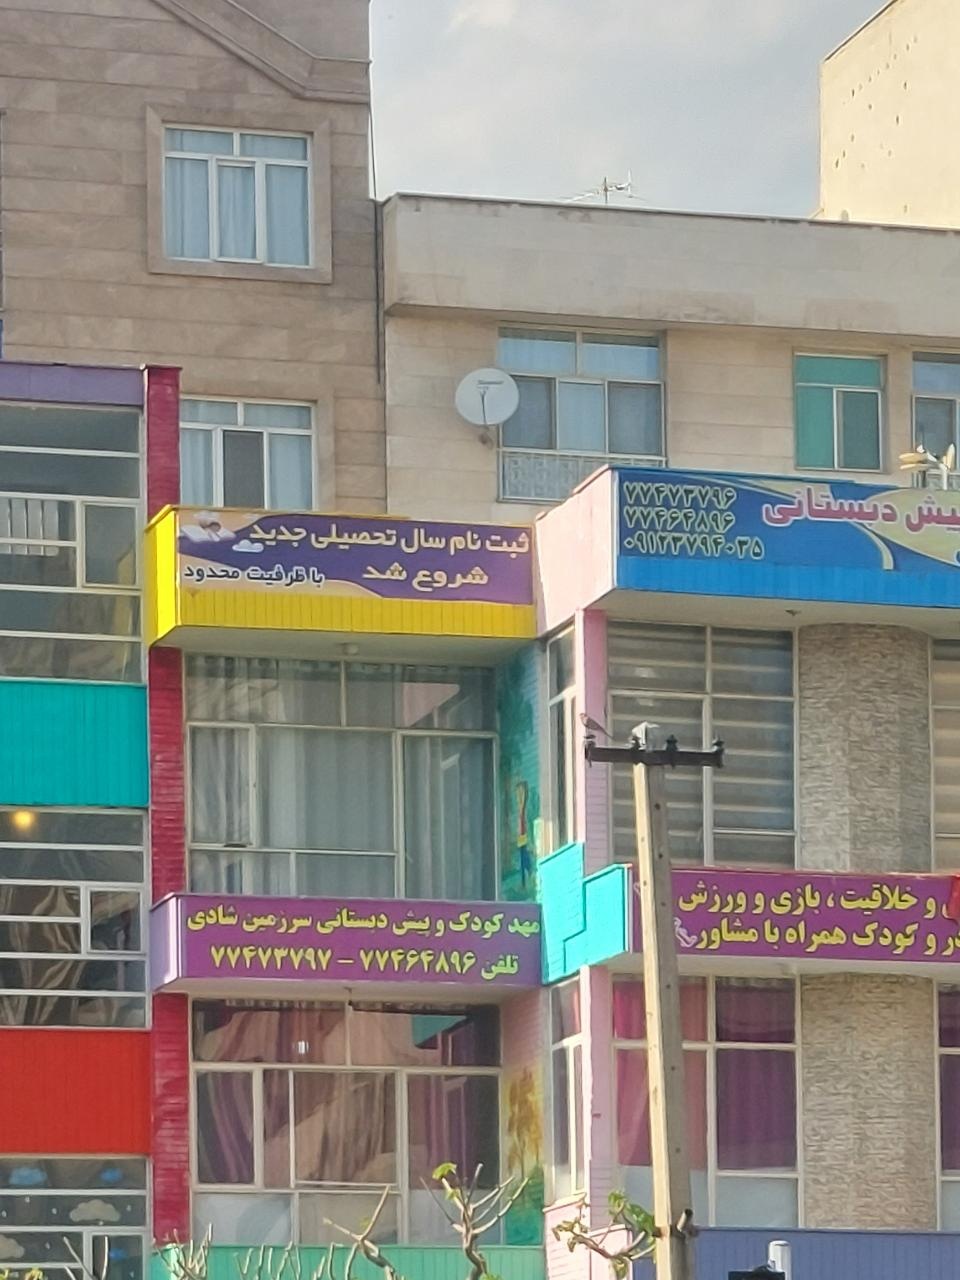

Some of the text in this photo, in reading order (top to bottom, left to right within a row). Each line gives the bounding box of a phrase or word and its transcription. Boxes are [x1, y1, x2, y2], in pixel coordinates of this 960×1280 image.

[624, 482, 736, 509] ۷۷۴۷۳۷۹۶
[763, 486, 898, 528] دبستانی
[624, 506, 736, 533] ۷۷۴۶۴۸۹۶
[249, 524, 529, 558] ثبت نام سال تحصیلی جدید
[624, 531, 765, 559] ۰۹۱۲۳۷۹۴۰۳۵
[184, 564, 325, 588] با ظرفیت محدود
[362, 562, 489, 592] شروع شد
[678, 880, 747, 913] ورزش
[752, 892, 765, 914] و
[770, 884, 820, 915] بازی
[923, 897, 936, 919] و
[187, 904, 540, 938] مهد کودک و پیش دبستانی سرزمین شادی
[696, 918, 758, 949] مشاور
[764, 919, 779, 950] با
[785, 920, 847, 952] همراه
[852, 922, 919, 954] کودک
[923, 933, 936, 955] و
[210, 945, 332, 971] ۷۷۴۷۳۷۹۷
[359, 949, 477, 974] ۷۷۴۶۴۸۹۶
[481, 954, 519, 980] تلفن
